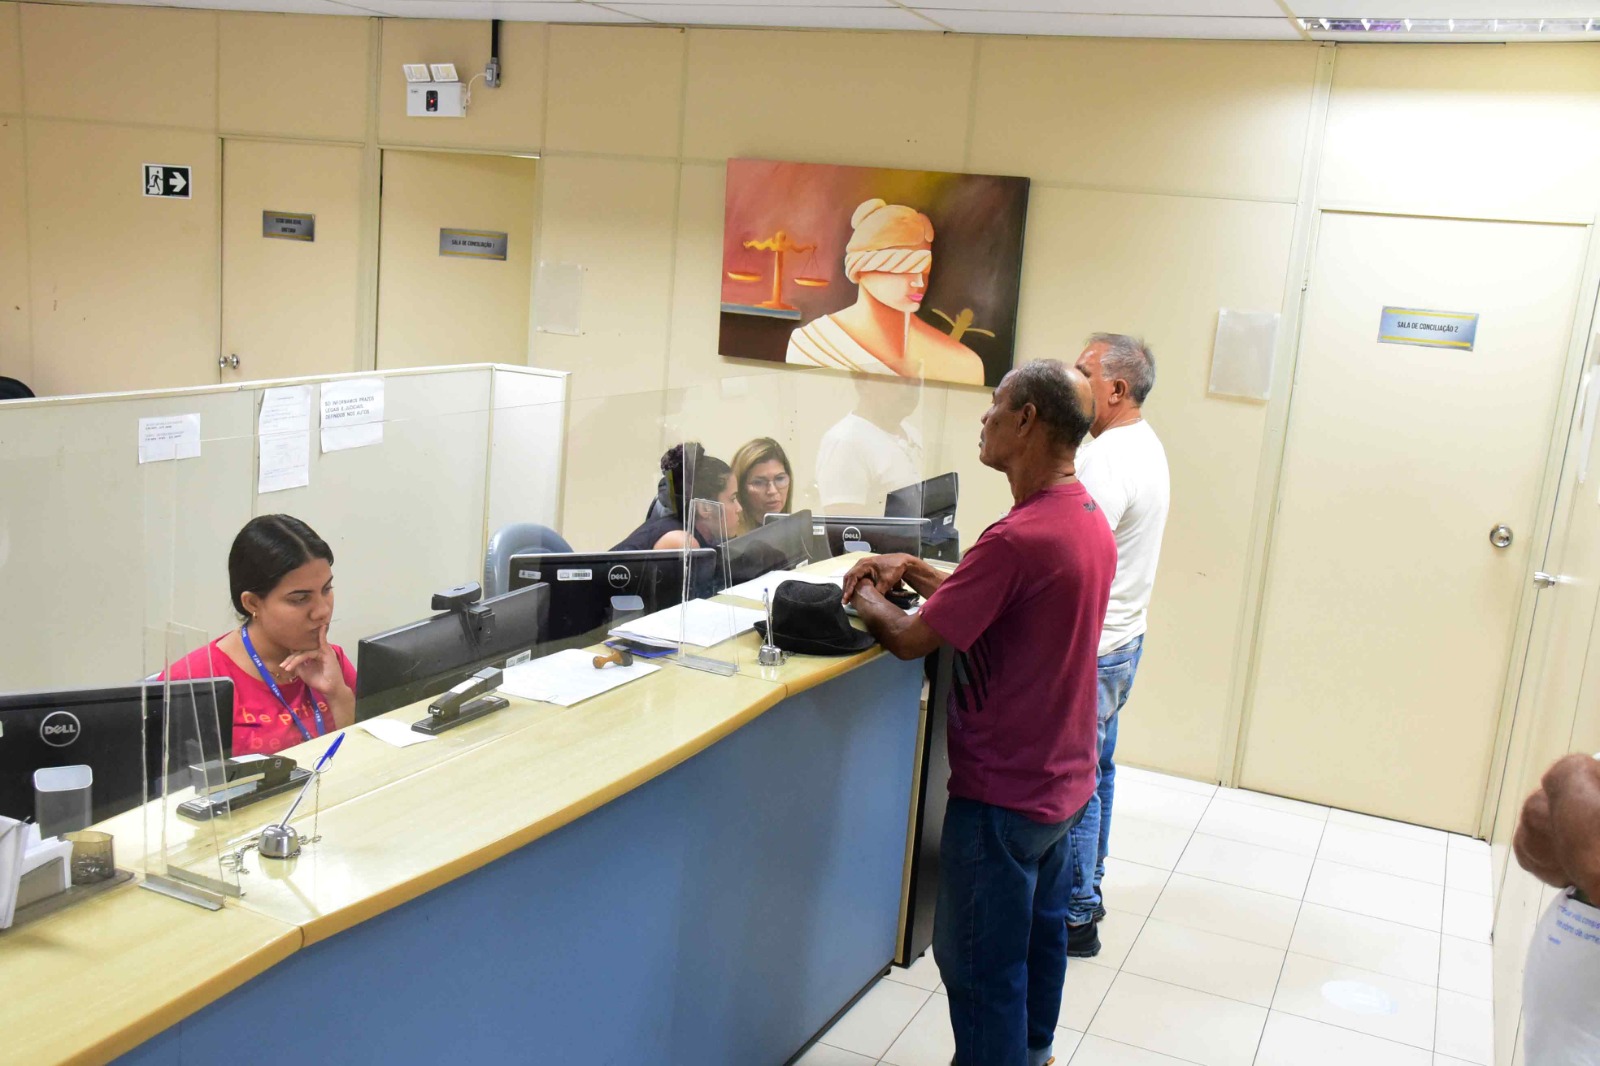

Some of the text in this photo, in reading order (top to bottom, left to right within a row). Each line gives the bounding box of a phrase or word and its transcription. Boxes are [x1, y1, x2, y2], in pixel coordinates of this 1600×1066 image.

[1397, 321, 1411, 329] SALA
[1419, 323, 1454, 333] CONCILIAÇÃO
[1454, 325, 1459, 333] 2
[252, 654, 263, 668] TJRR
[242, 707, 271, 723] be
[44, 724, 76, 735] DELL
